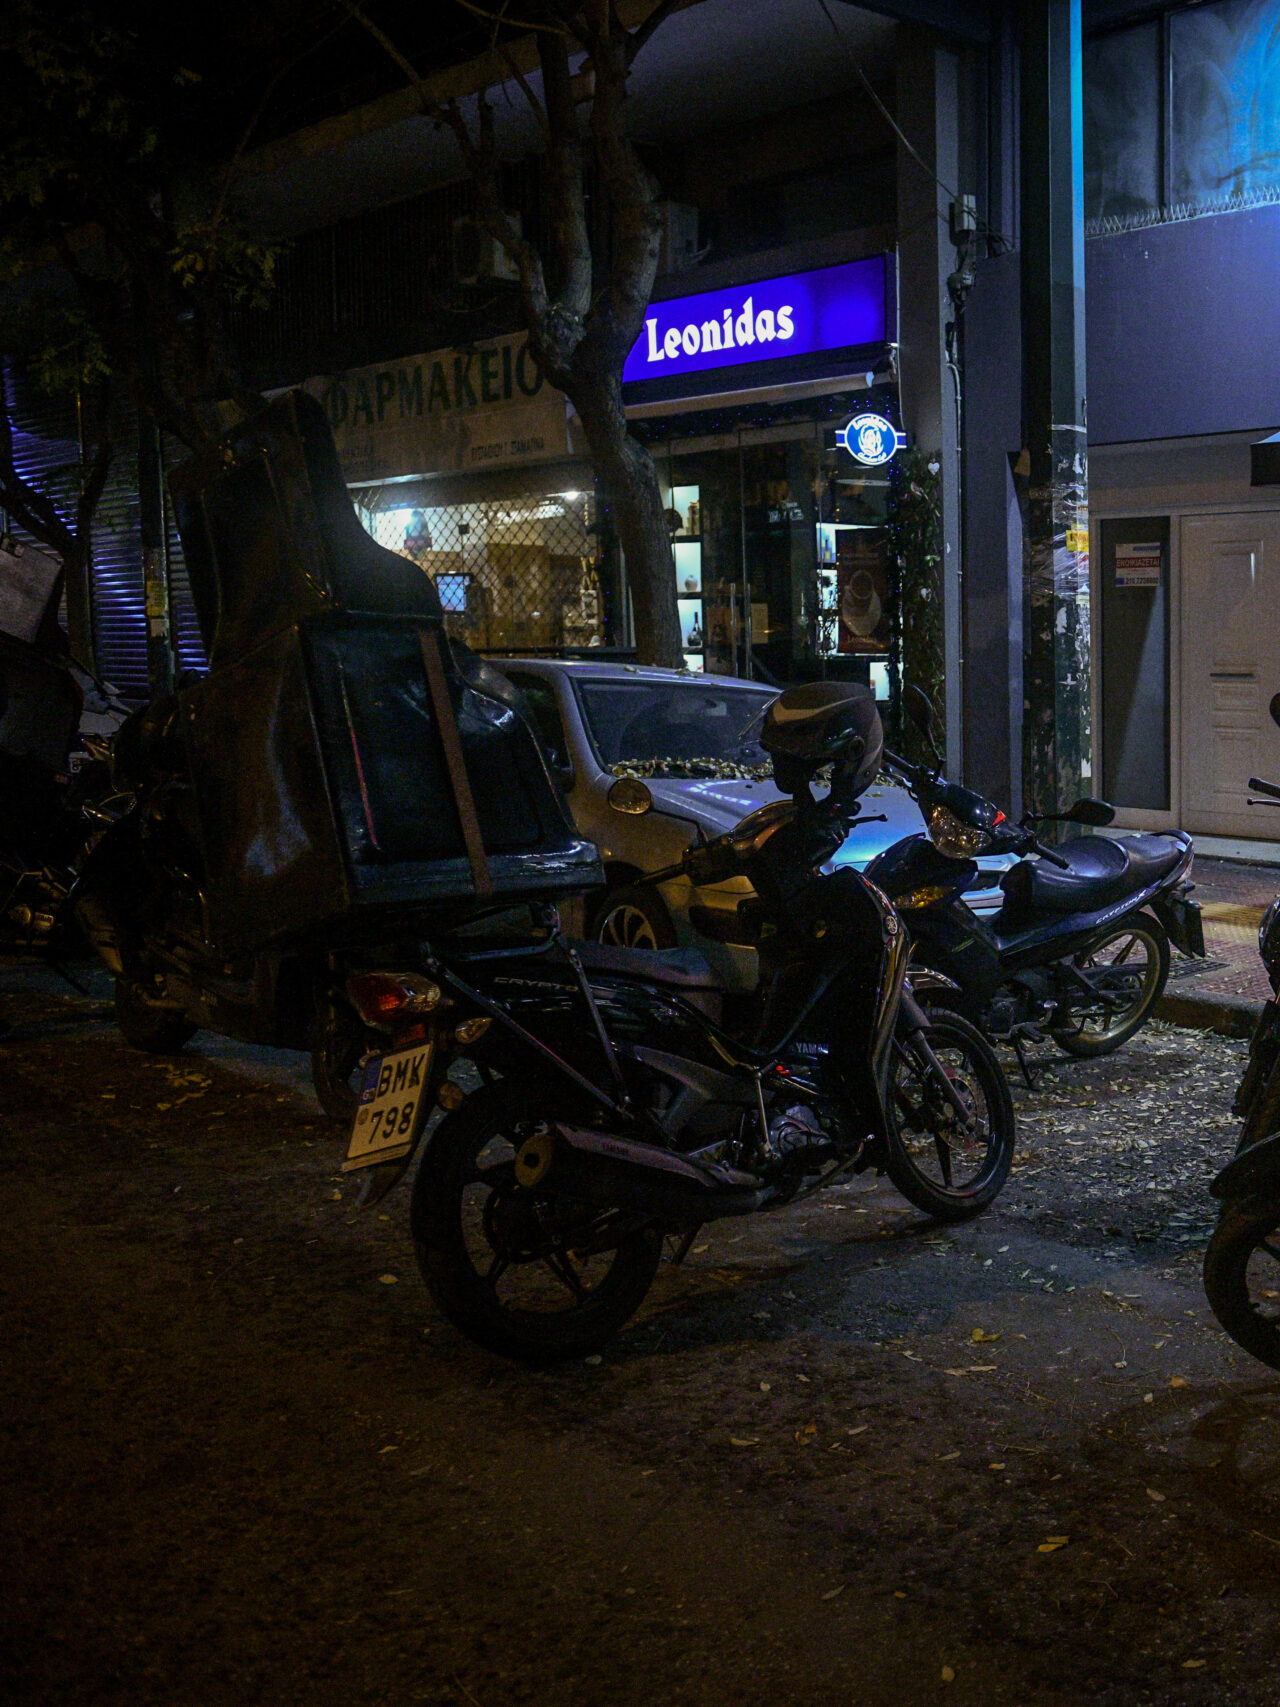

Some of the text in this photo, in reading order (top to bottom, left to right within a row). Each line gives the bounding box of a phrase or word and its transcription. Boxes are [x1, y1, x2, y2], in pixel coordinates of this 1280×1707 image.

[645, 296, 794, 362] Leonidas
[493, 976, 580, 992] CRYPTO
[377, 1053, 426, 1098] BMK
[368, 1102, 414, 1144] 798
